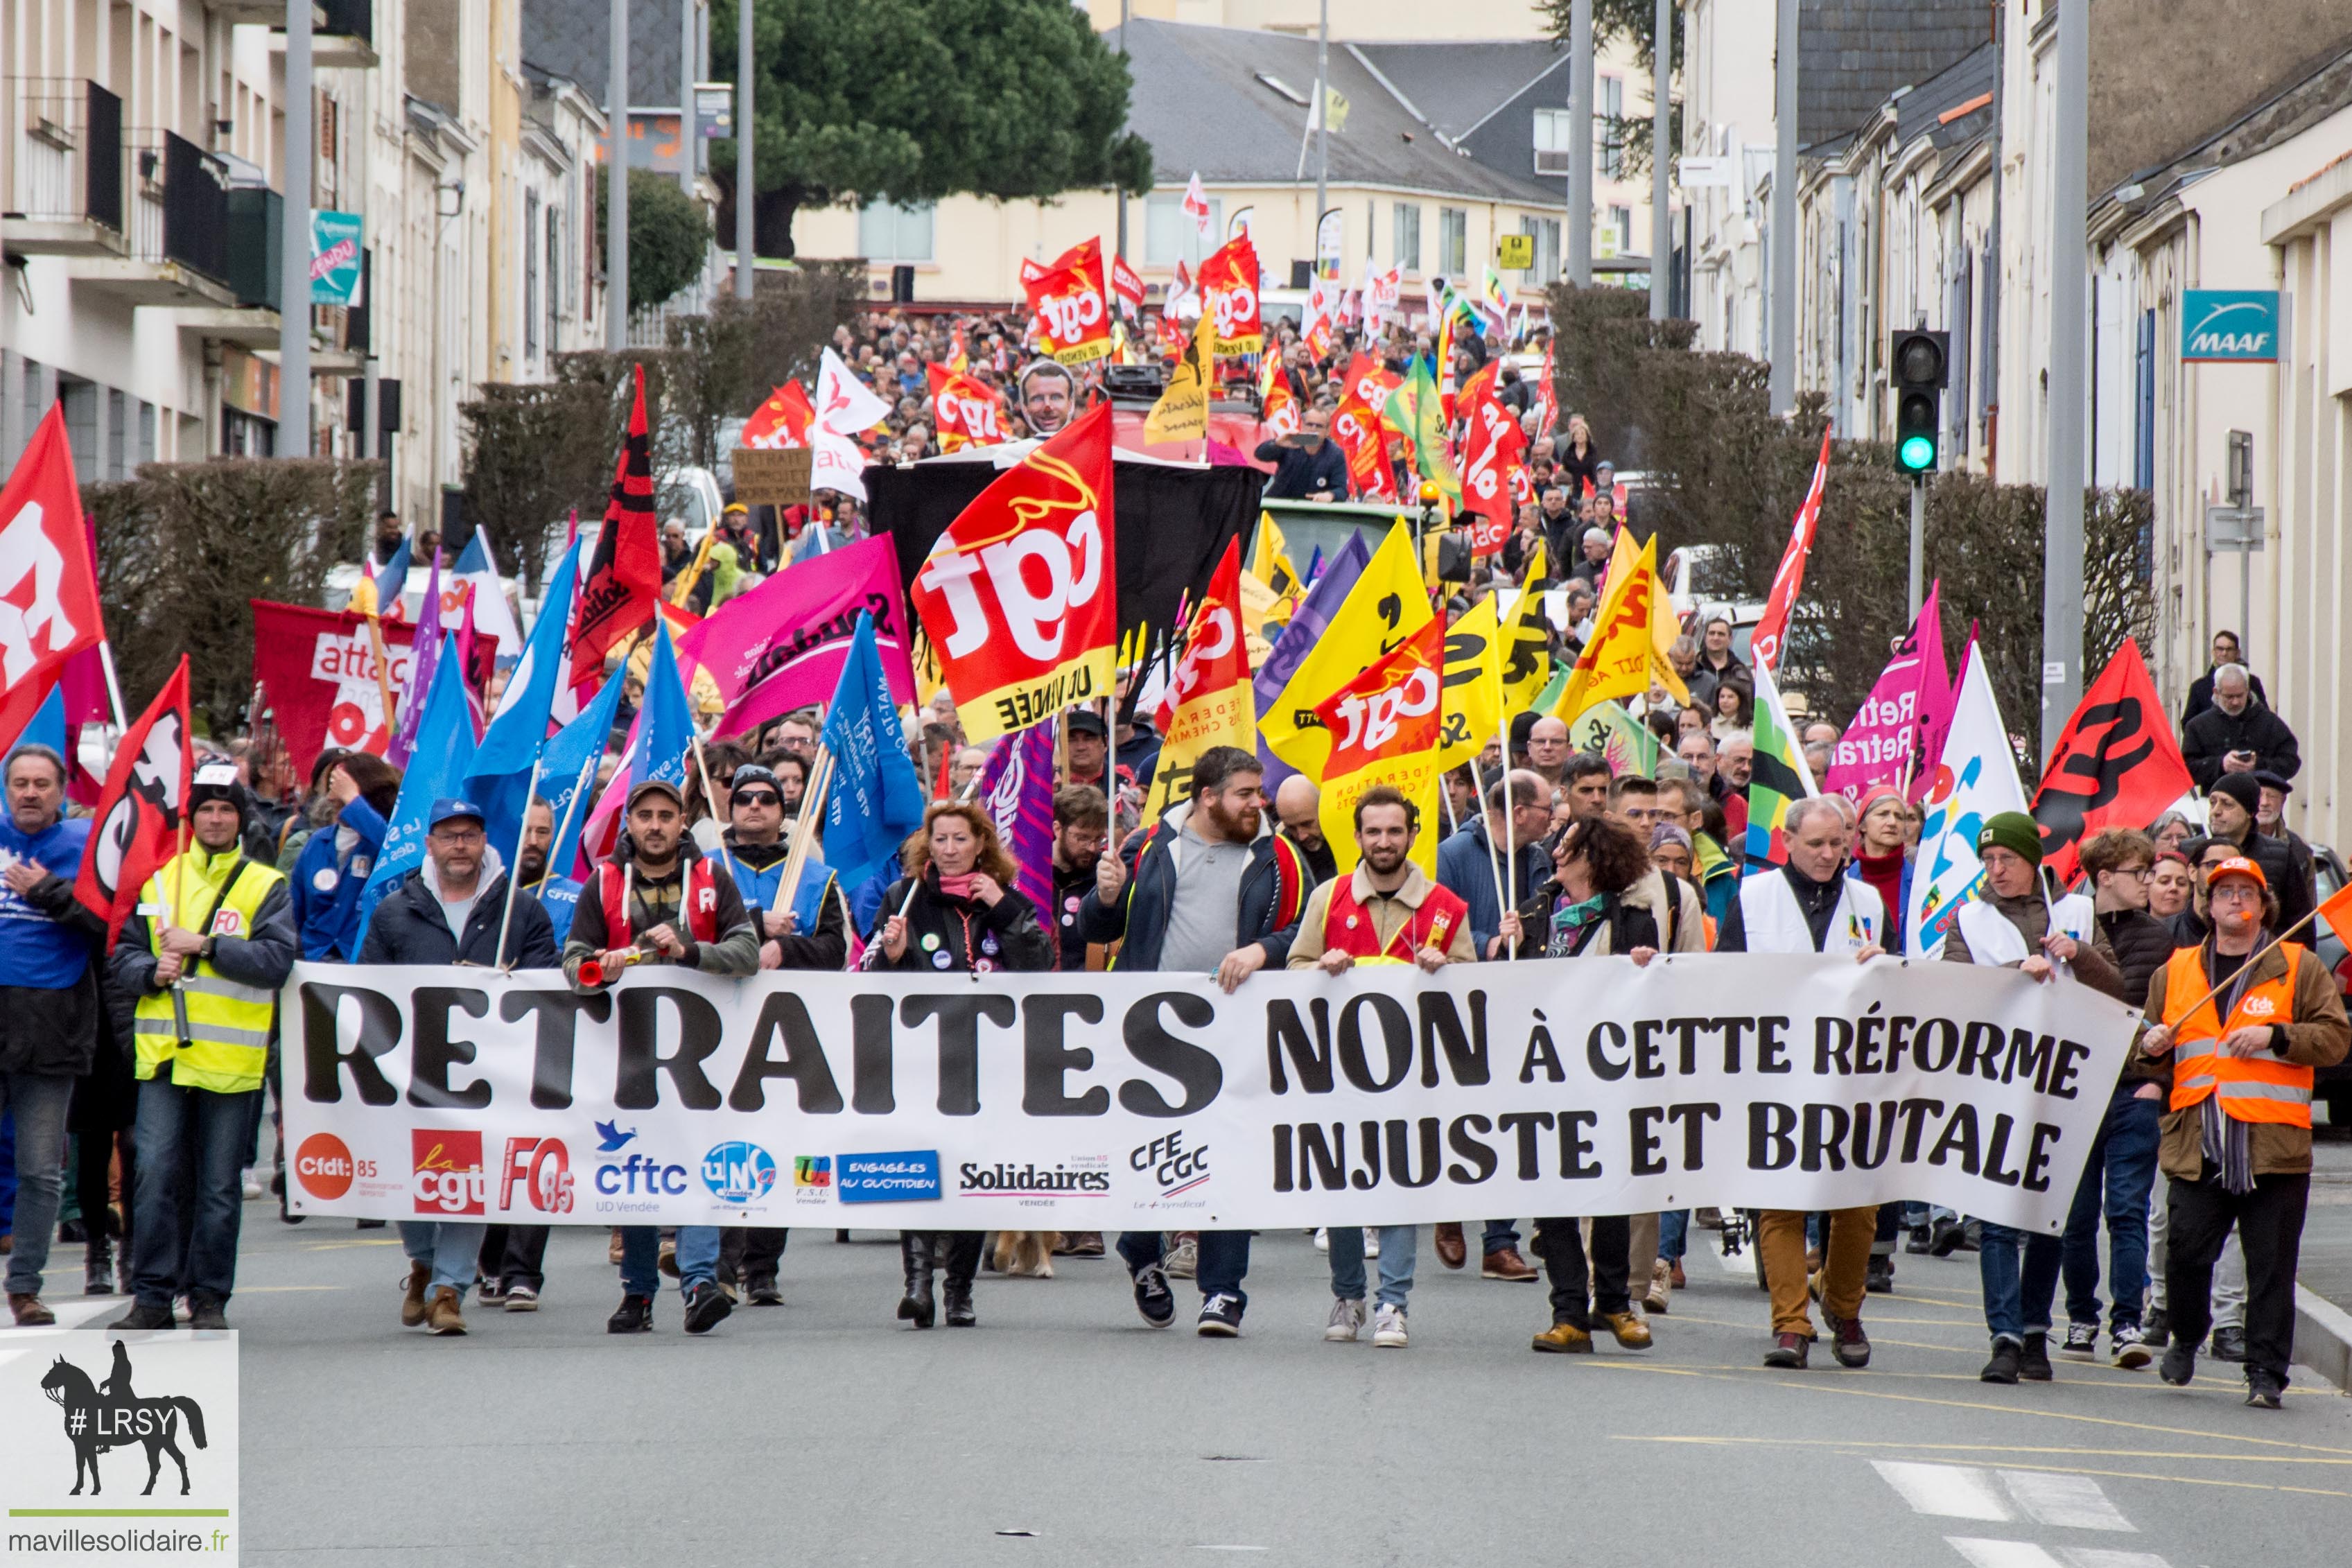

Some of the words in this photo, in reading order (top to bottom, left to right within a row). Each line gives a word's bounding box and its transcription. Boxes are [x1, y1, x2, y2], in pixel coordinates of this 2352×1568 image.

[2190, 332, 2270, 352] MAAF
[937, 392, 1002, 438] cgt
[320, 642, 408, 684] attac
[212, 910, 239, 934] FO
[299, 982, 1223, 1117] RETRAITES
[1266, 989, 1490, 1095] NON
[1519, 1007, 1566, 1083] À
[1586, 1016, 1792, 1081] CETTE
[1813, 1000, 2091, 1100] RÉFORME
[415, 1143, 483, 1173] la
[1129, 1129, 1183, 1171] CFE
[1272, 1110, 1603, 1193] INJUSTE
[1628, 1101, 1721, 1176] ET
[1746, 1097, 2062, 1193] BRUTALE
[357, 1160, 377, 1178] 85
[499, 1137, 569, 1213] FO
[542, 1171, 575, 1214] 85
[595, 1154, 688, 1196] cftc
[960, 1162, 1110, 1191] Solidaires
[1156, 1144, 1209, 1187] CGC
[412, 1164, 485, 1212] cgt
[724, 1189, 753, 1197] Vendée
[839, 1180, 857, 1188] AU
[862, 1178, 936, 1190] QUOTIDIEN
[595, 1202, 613, 1212] UD
[618, 1201, 660, 1212] Vendée
[1161, 1200, 1206, 1210] syndical
